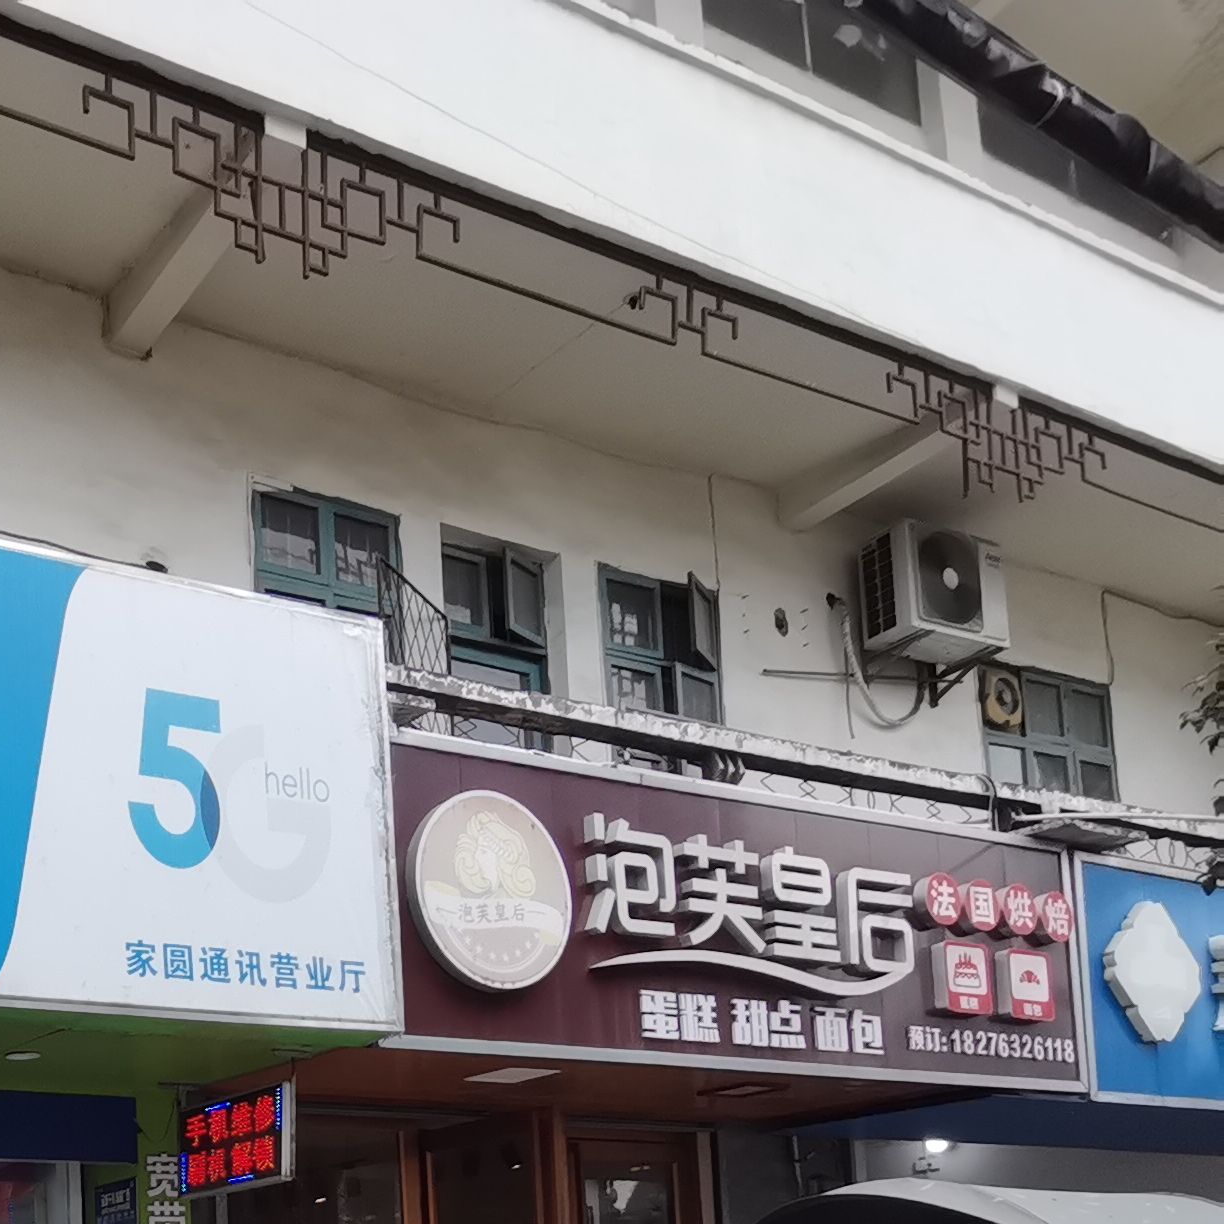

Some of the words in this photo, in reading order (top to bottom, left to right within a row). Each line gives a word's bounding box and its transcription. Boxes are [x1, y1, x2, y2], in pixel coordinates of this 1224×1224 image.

[128, 688, 331, 904] 5G
[265, 761, 330, 803] hello
[458, 903, 525, 924] 泡芙皇后
[583, 812, 914, 976] 泡芙皇后
[930, 879, 1070, 936] 法国烘焙
[125, 939, 366, 995] 家圆通讯营业厅
[639, 988, 720, 1043] 蛋糕
[730, 997, 806, 1049] 甜点
[813, 1005, 885, 1054] 面包
